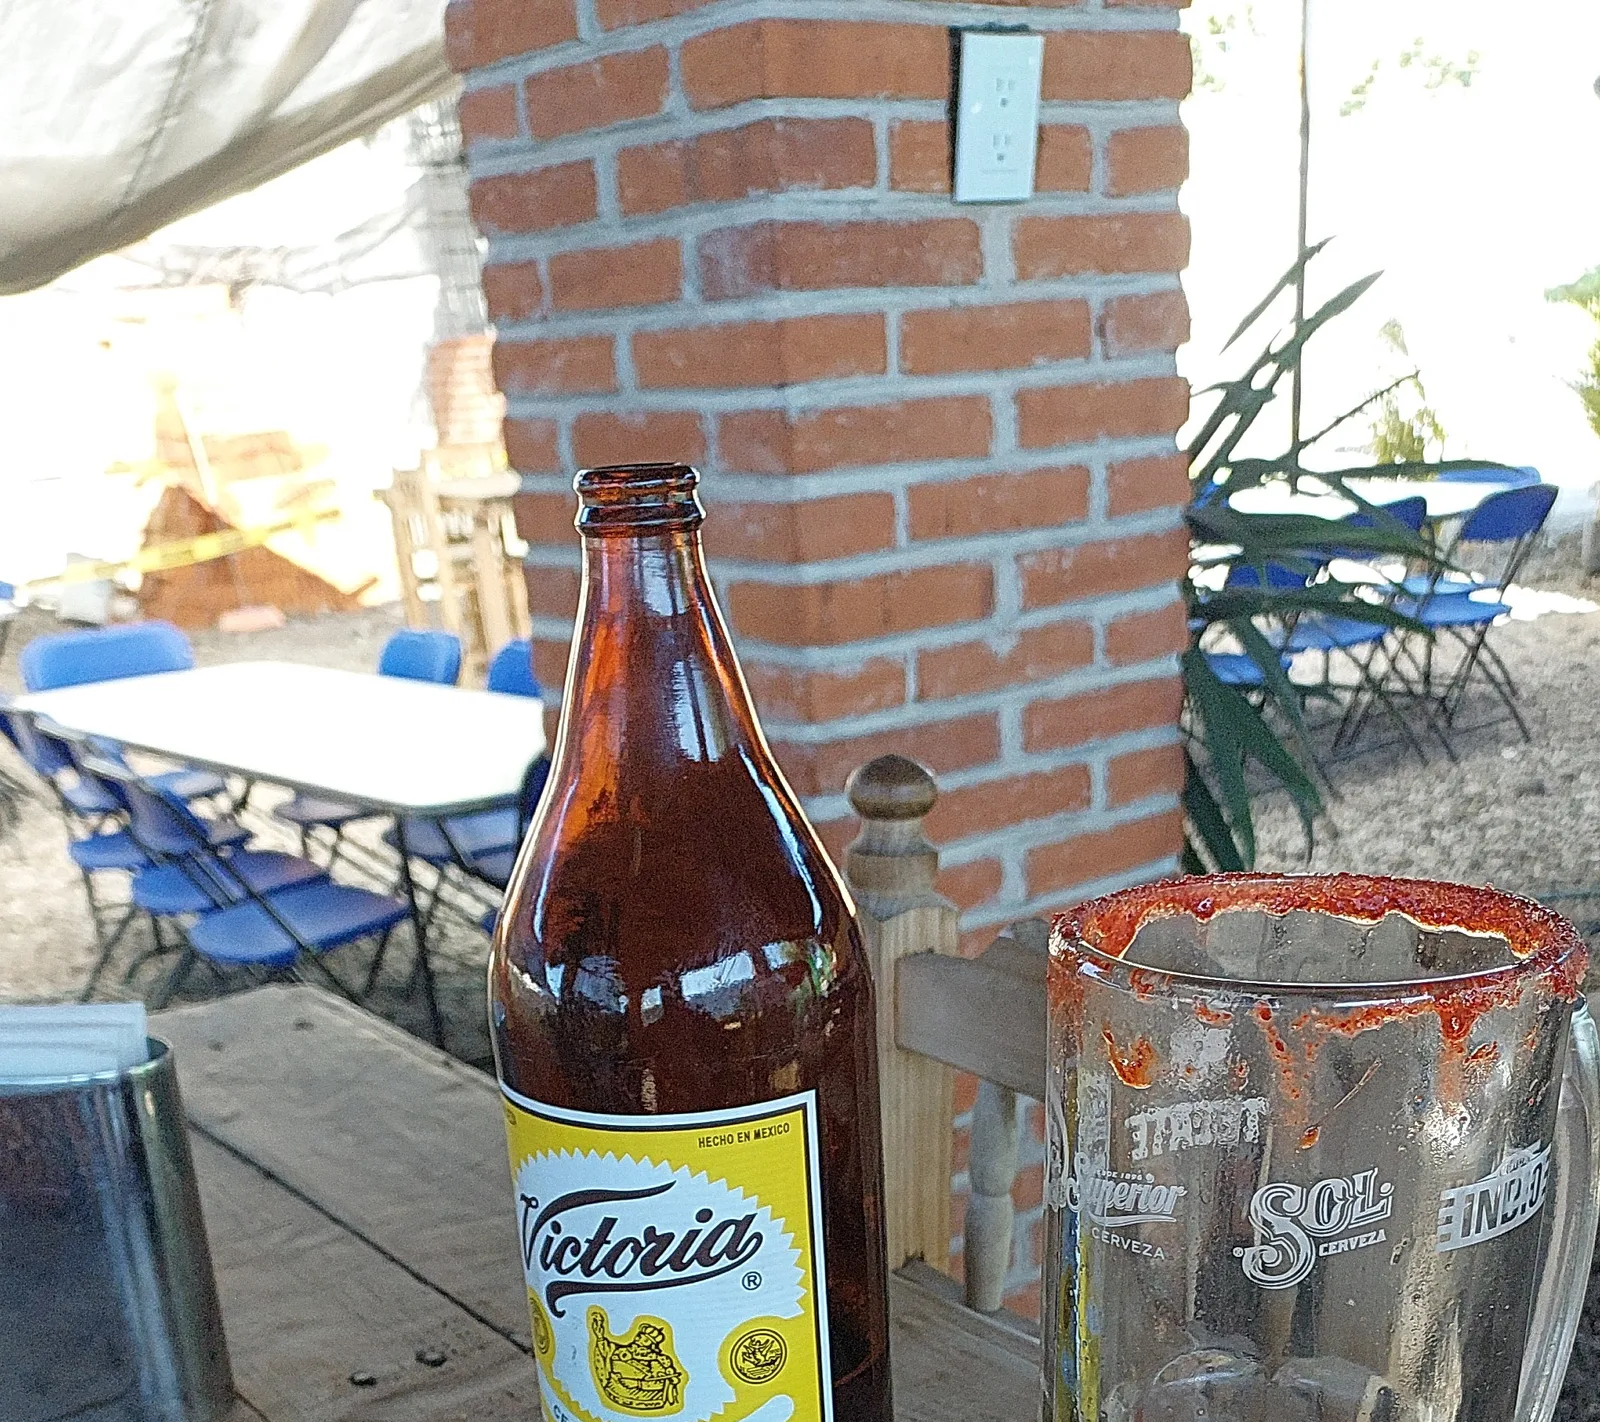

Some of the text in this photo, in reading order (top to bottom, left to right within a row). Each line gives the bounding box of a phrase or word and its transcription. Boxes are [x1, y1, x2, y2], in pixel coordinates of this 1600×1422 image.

[698, 1122, 790, 1148] HECHO EN MEXICO
[520, 1180, 764, 1292] Victoria
[1091, 1226, 1165, 1260] CERVEZA
[1242, 1167, 1395, 1290] SOL
[1318, 1229, 1387, 1257] CERVEZA
